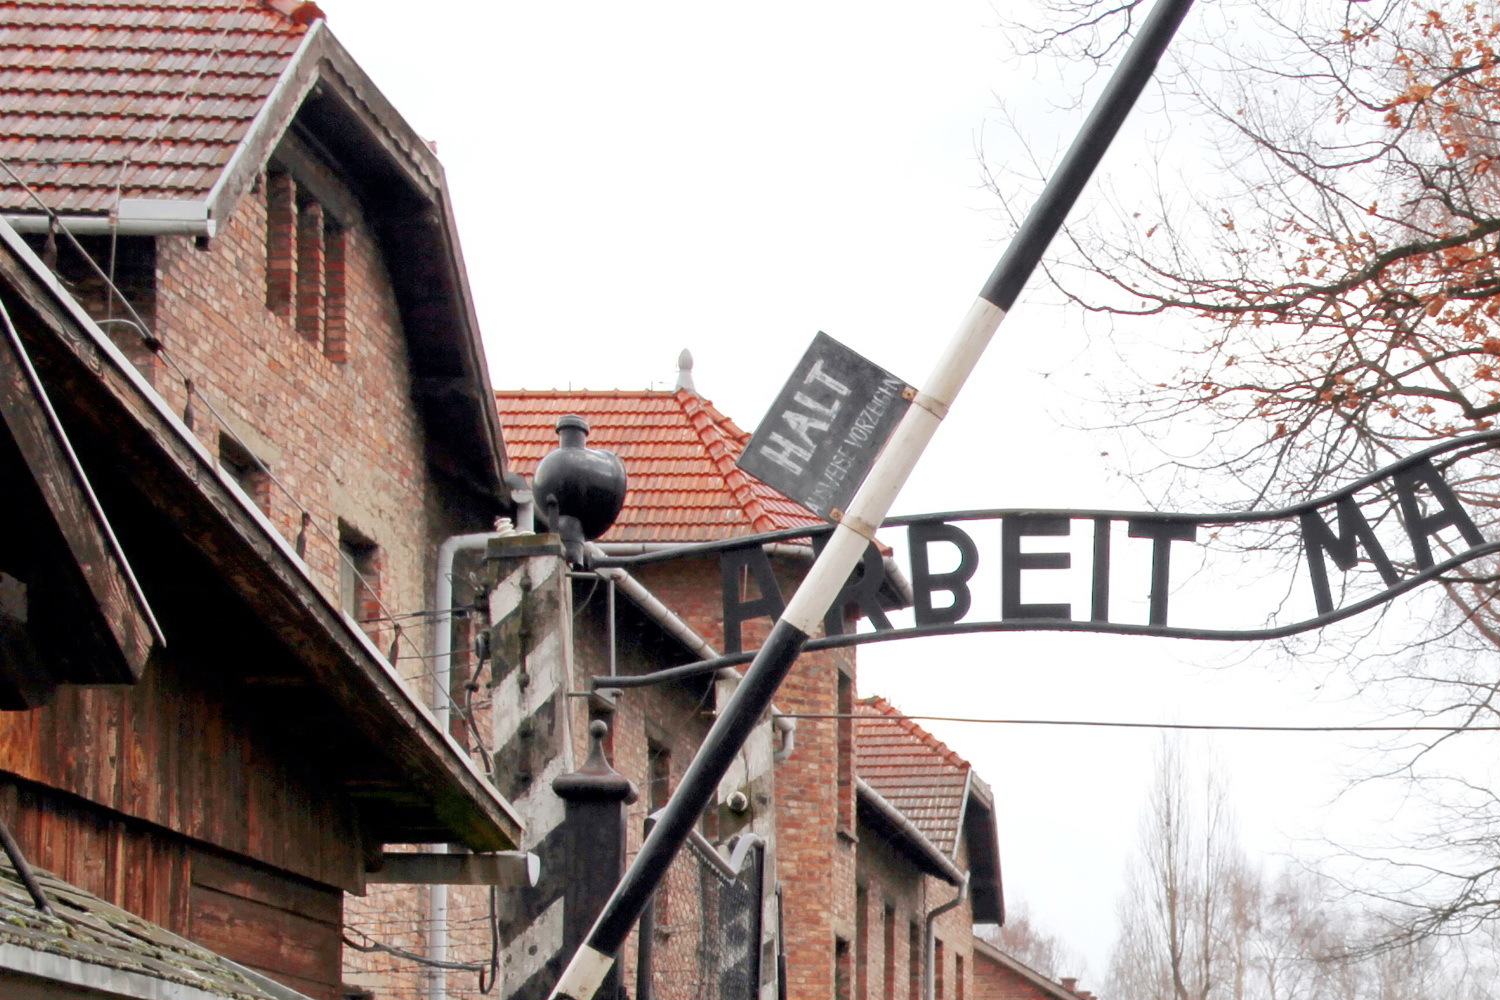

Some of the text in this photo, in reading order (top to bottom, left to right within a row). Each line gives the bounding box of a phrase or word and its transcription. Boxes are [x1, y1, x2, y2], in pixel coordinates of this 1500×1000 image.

[760, 359, 852, 476] HALT
[804, 446, 856, 515] AUSWEISE
[720, 516, 1197, 654] ARBEIT
